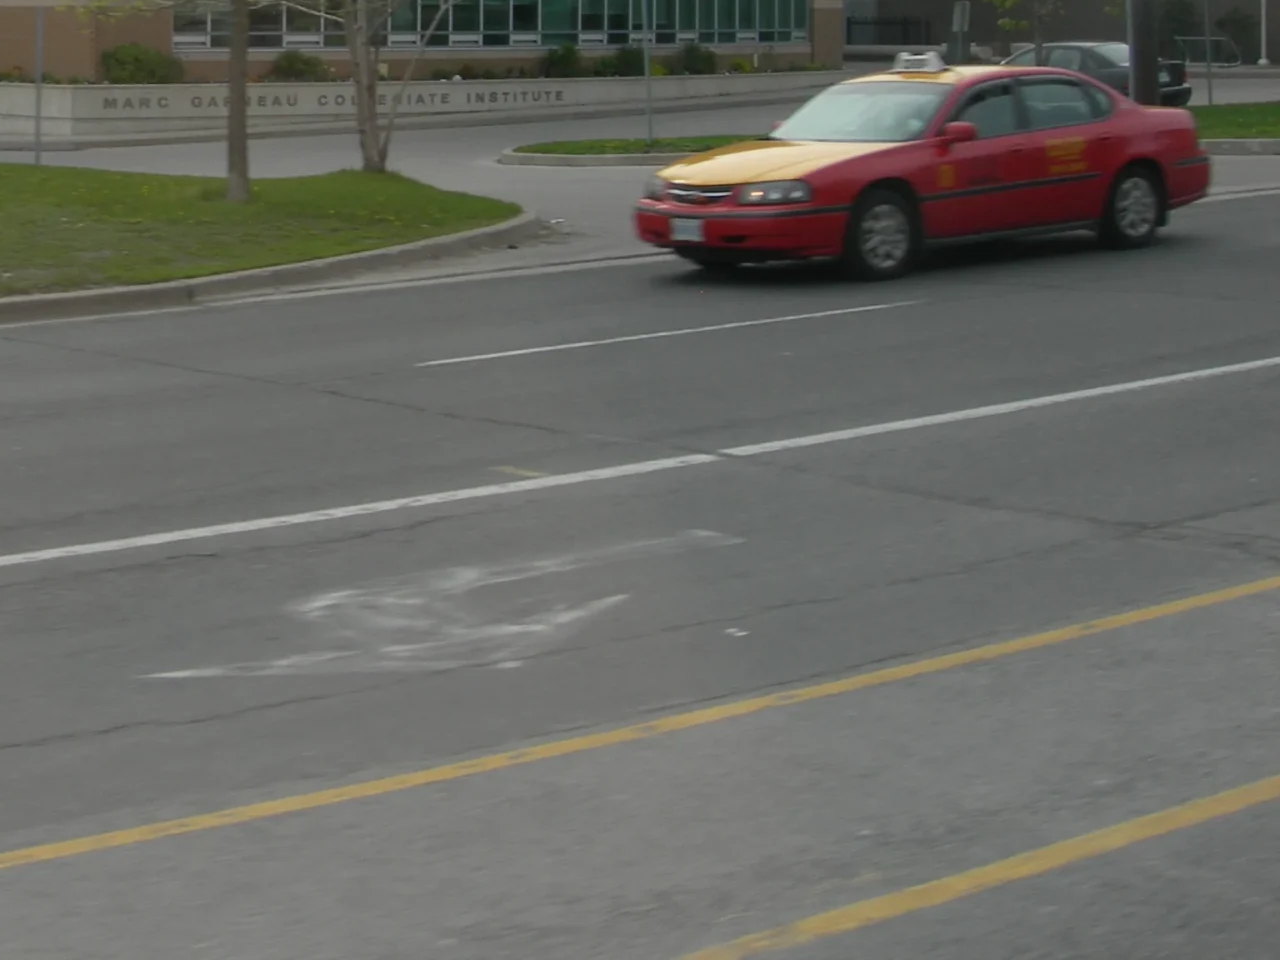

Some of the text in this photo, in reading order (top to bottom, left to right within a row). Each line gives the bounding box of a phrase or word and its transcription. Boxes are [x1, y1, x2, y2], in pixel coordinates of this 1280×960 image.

[103, 96, 169, 109] MARC
[317, 93, 450, 107] COLEIATE
[467, 90, 564, 104] INSTITUTE
